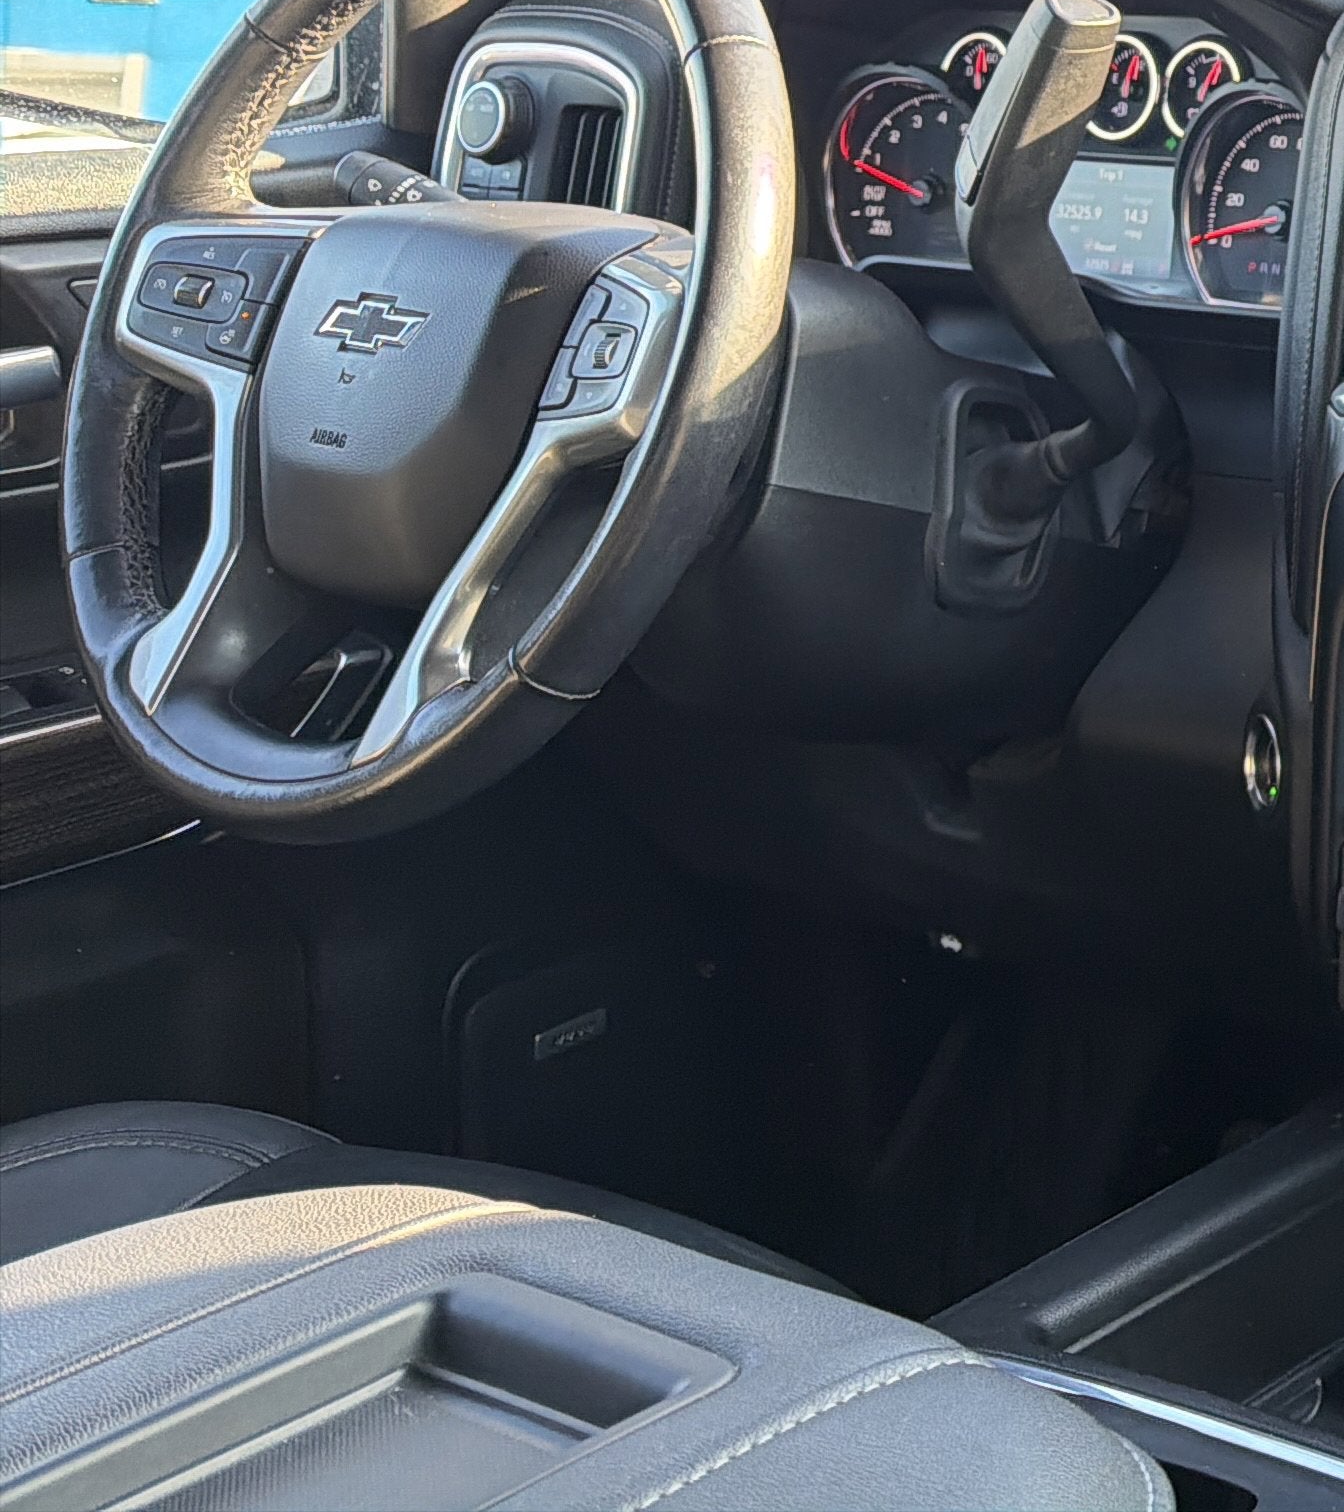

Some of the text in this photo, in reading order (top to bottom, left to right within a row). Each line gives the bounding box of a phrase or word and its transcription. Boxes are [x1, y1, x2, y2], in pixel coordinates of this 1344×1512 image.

[911, 114, 923, 129] 3
[936, 110, 948, 125] 4
[888, 129, 901, 144] 2
[1268, 134, 1288, 149] 60
[874, 152, 881, 166] 1
[1240, 158, 1260, 173] 40
[1225, 192, 1245, 207] 20
[864, 205, 886, 218] OFF
[1124, 207, 1150, 225] 14.3
[1220, 234, 1233, 248] 0
[1247, 261, 1257, 273] P
[1271, 262, 1281, 274] N
[309, 427, 348, 449] AIRBAG
